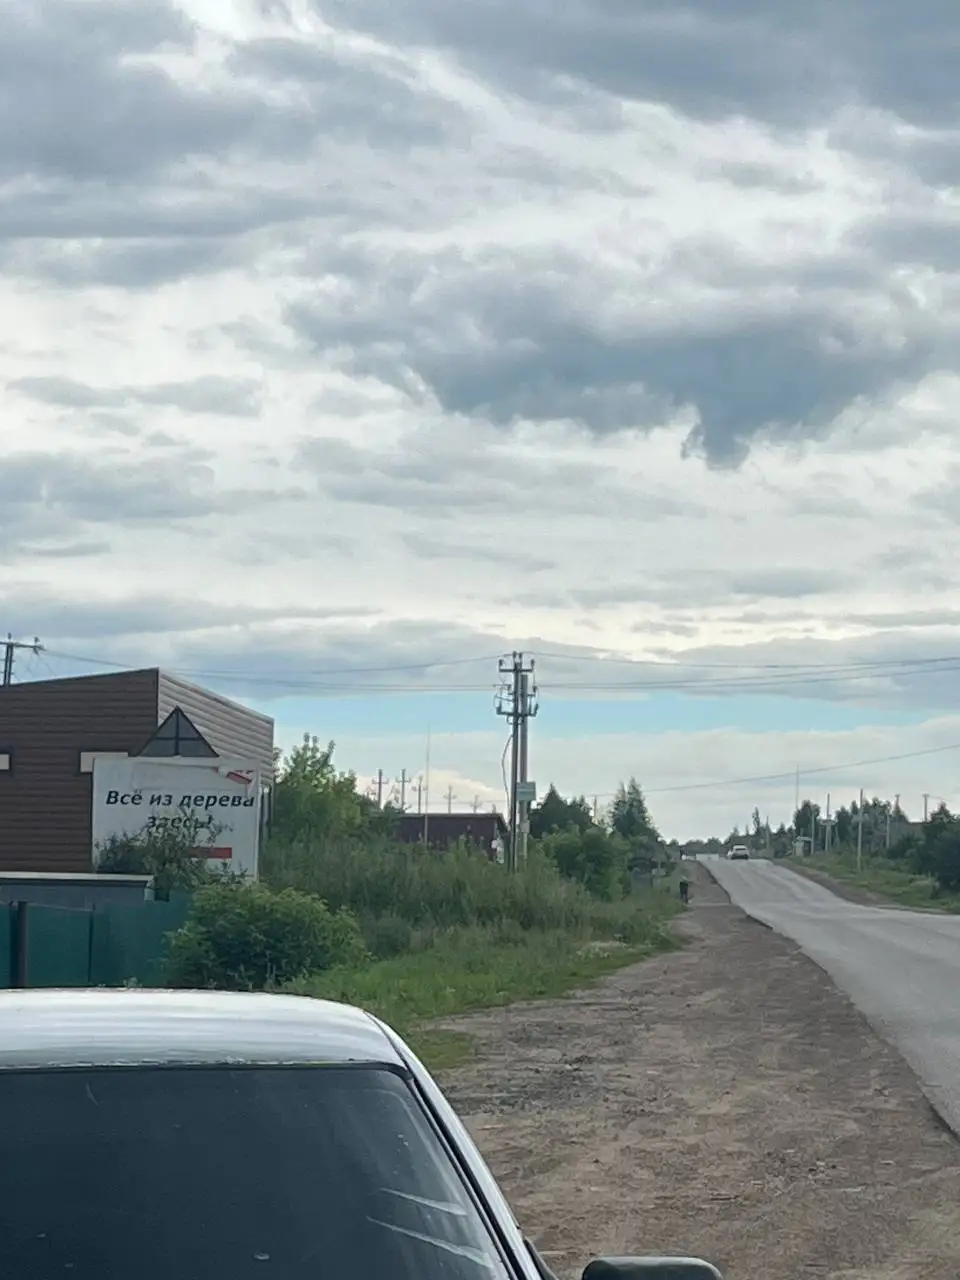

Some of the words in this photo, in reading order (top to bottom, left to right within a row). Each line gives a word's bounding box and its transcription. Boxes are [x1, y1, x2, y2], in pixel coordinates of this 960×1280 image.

[105, 789, 142, 806] Всё
[148, 793, 172, 807] из
[178, 794, 255, 811] дерева
